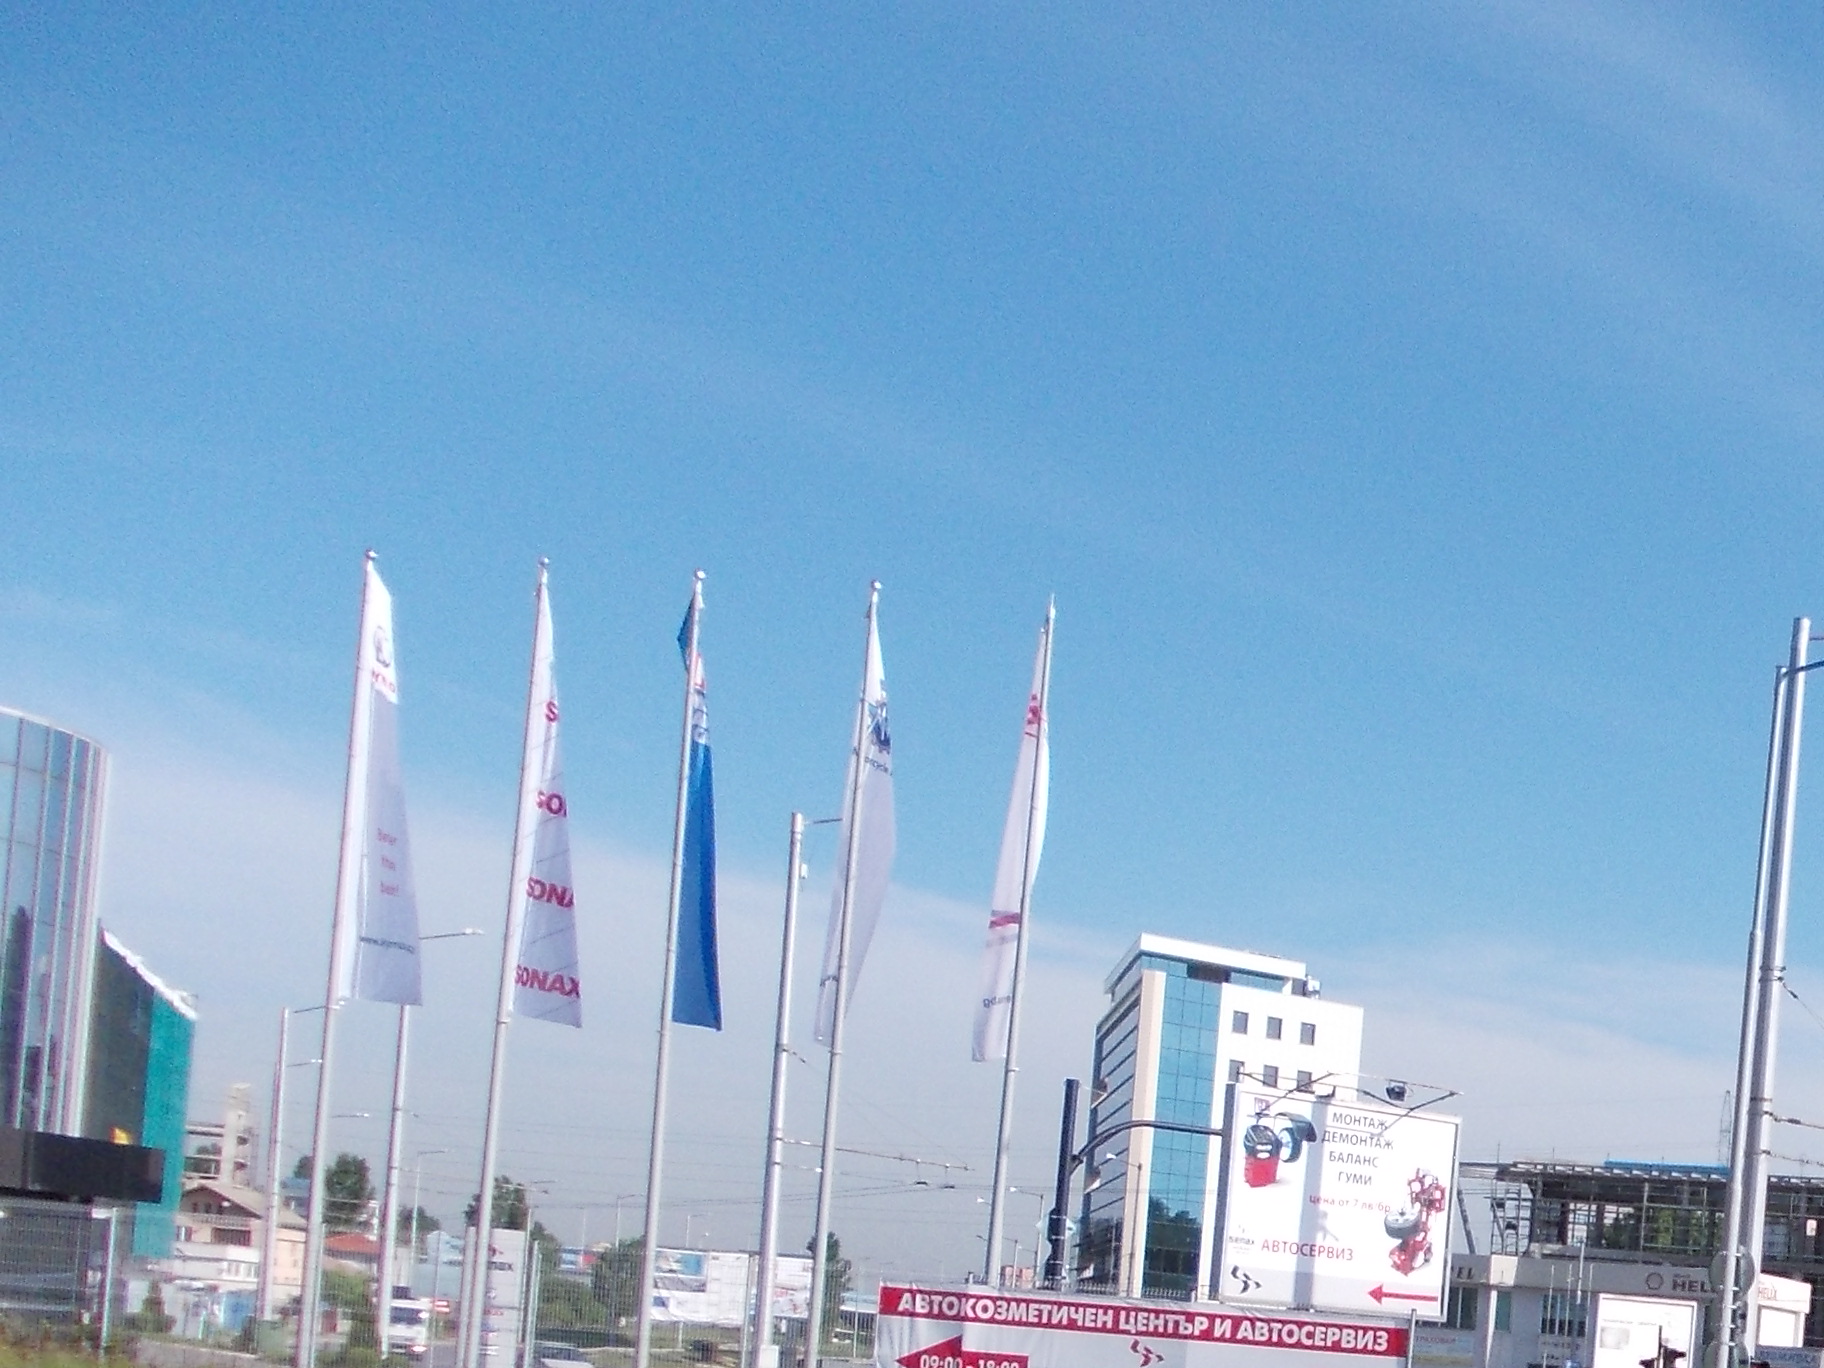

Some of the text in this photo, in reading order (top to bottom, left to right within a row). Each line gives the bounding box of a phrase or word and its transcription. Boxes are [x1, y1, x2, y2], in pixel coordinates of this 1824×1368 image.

[515, 964, 580, 999] SONAX
[1332, 1112, 1388, 1131] МОНТАЖ
[1321, 1130, 1394, 1150] ДЕМОНТАЖ
[1329, 1150, 1380, 1169] БАЛАНС
[1338, 1171, 1373, 1186] ГУМИ
[1261, 1239, 1354, 1261] АВТОСЕРВИЗ
[897, 1292, 1389, 1351] АВТОКОЗМЕТИЧЕН ЦЕНТЪР И АВТОСЕРВИЗ
